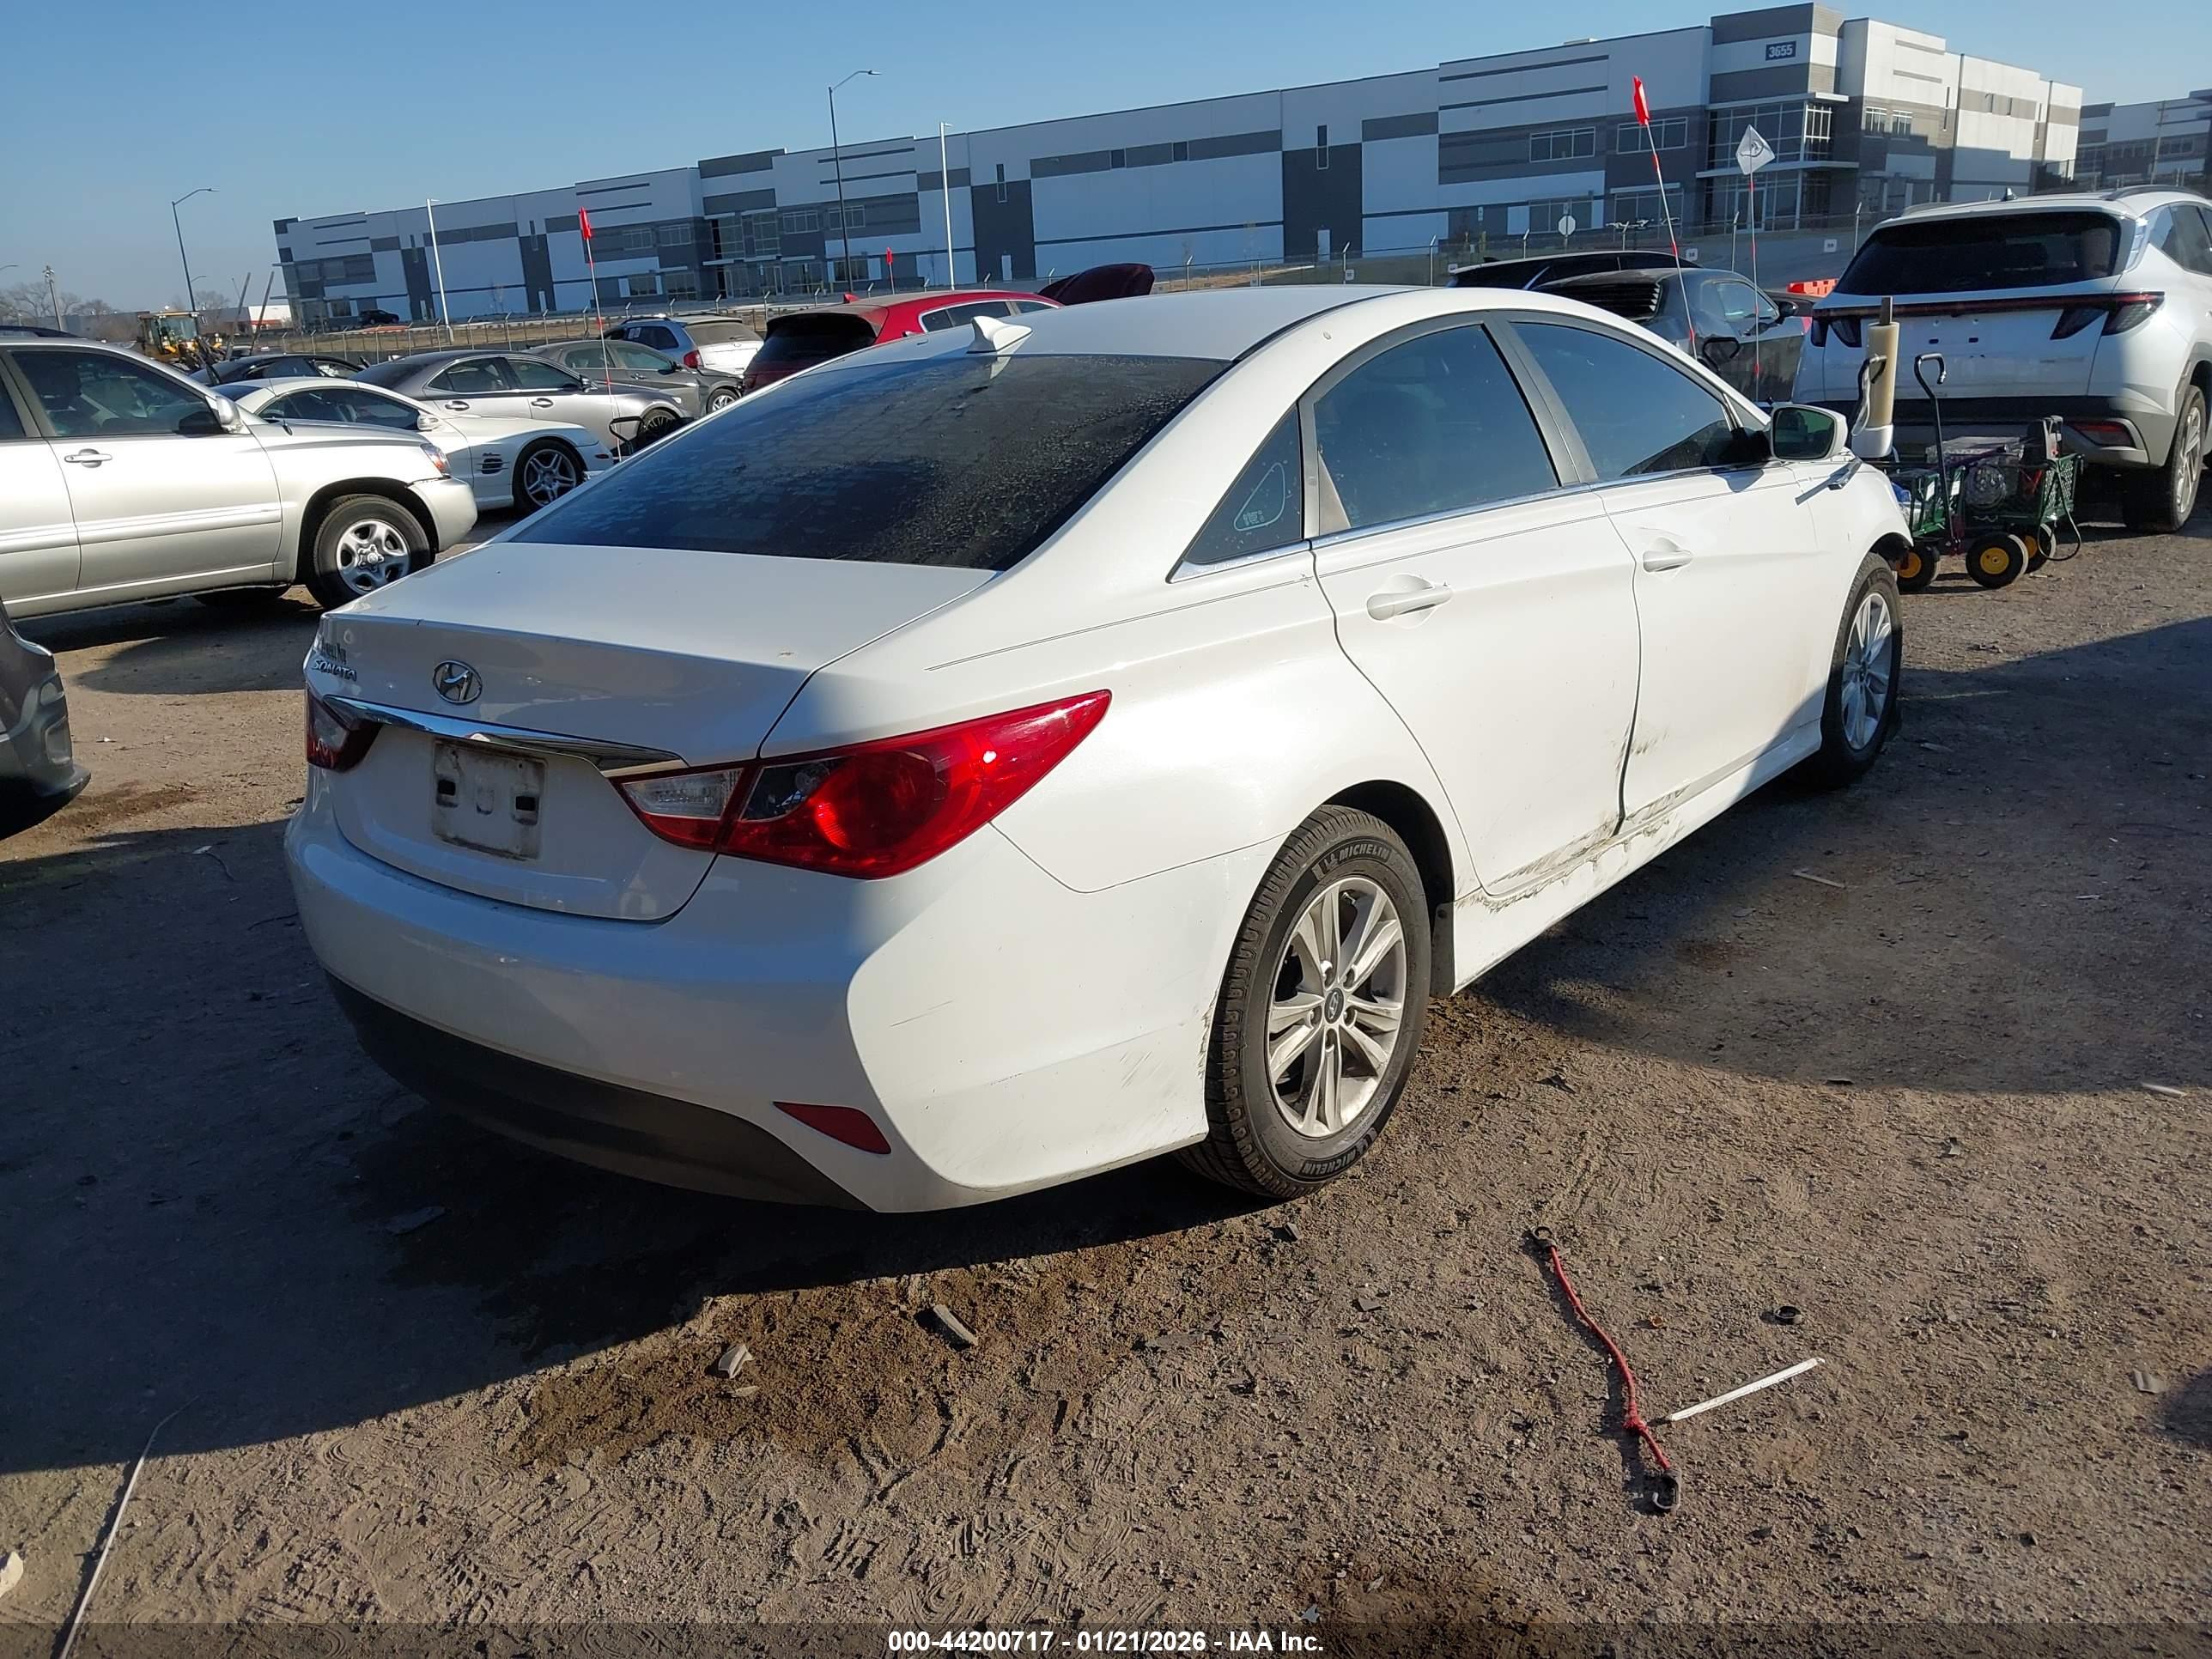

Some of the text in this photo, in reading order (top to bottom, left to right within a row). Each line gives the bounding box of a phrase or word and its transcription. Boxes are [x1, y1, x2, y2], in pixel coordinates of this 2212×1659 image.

[1769, 44, 1793, 58] 3655
[313, 659, 357, 681] SONATA
[1339, 843, 1389, 861] MICHELIN
